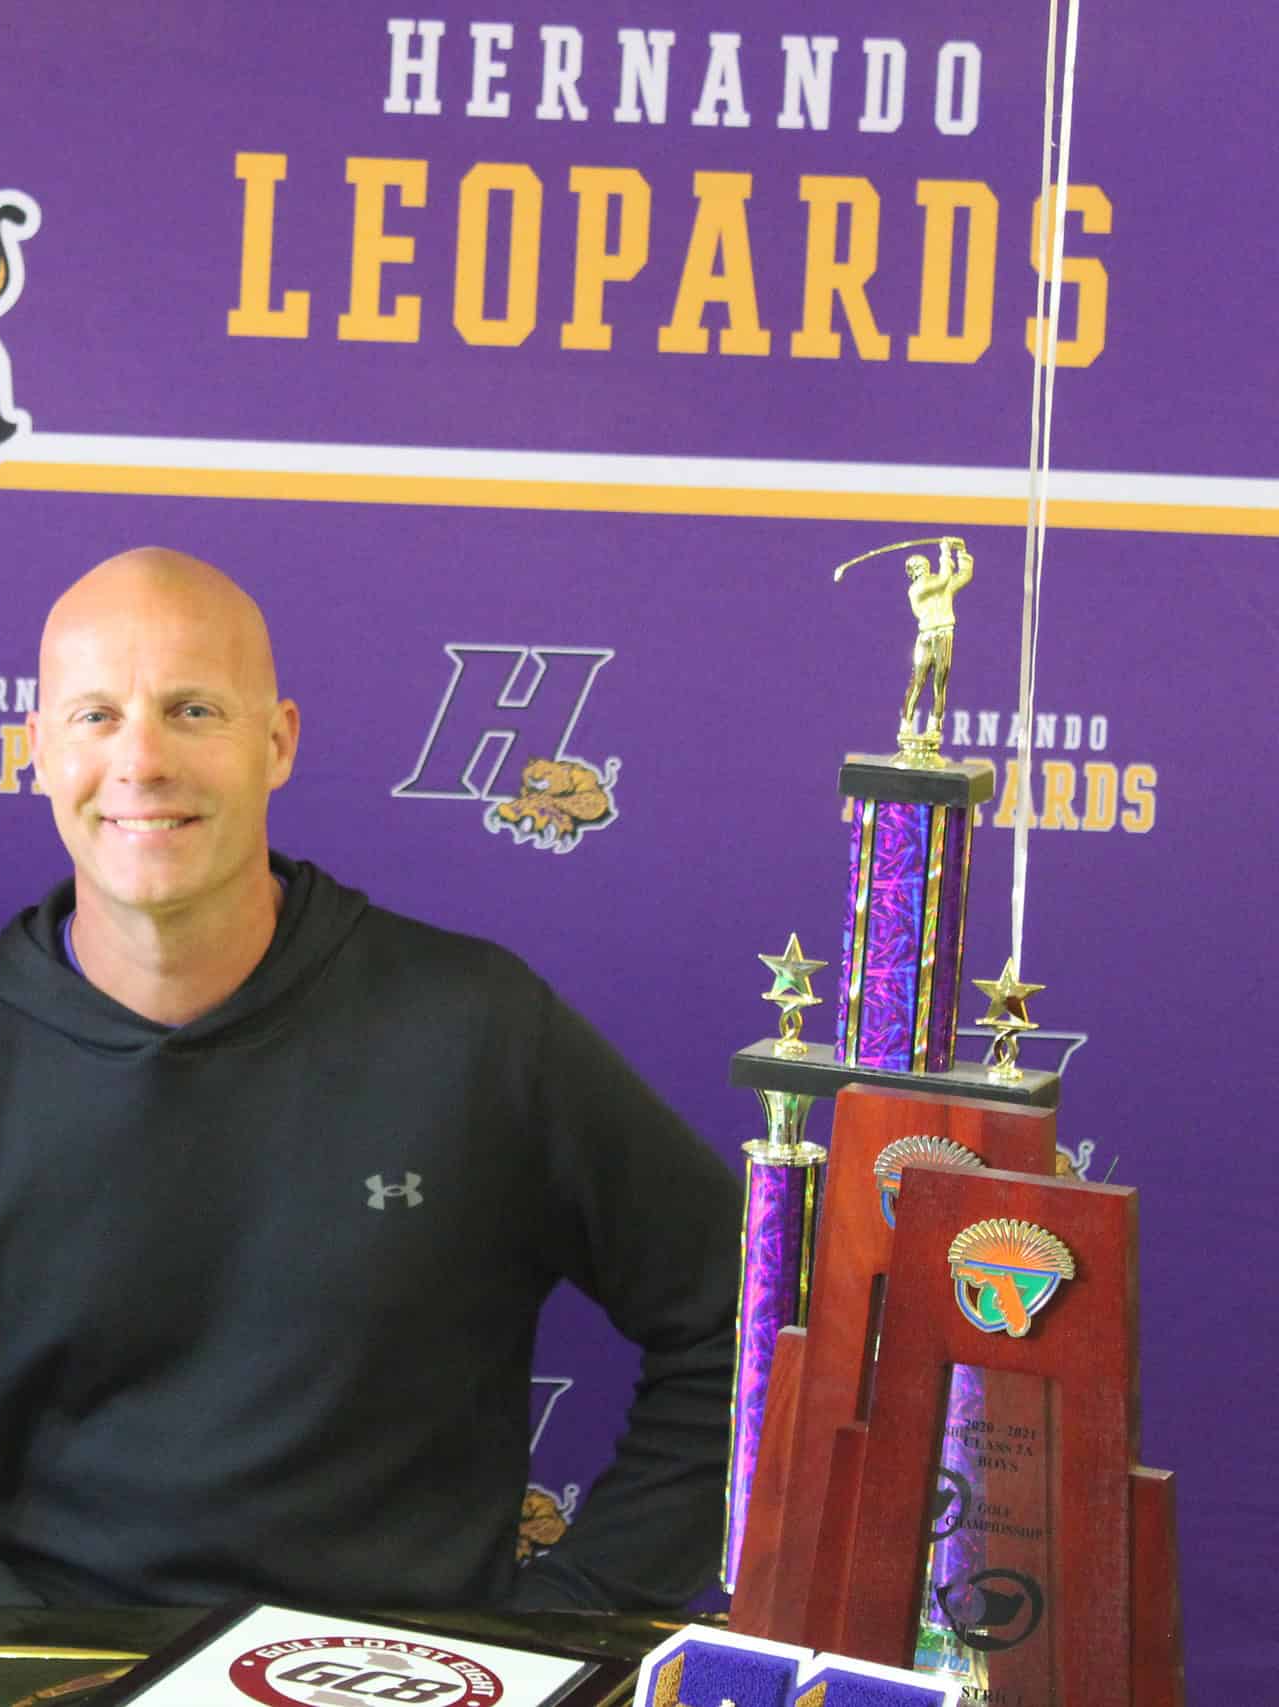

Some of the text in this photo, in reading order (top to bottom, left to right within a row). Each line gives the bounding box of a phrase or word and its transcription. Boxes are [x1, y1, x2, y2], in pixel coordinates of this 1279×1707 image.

[383, 18, 982, 136] HERNANDO
[227, 151, 1113, 369] LEOPARDS
[254, 1637, 496, 1698] GULF COAST EIGHT
[276, 1661, 462, 1703] GC8
